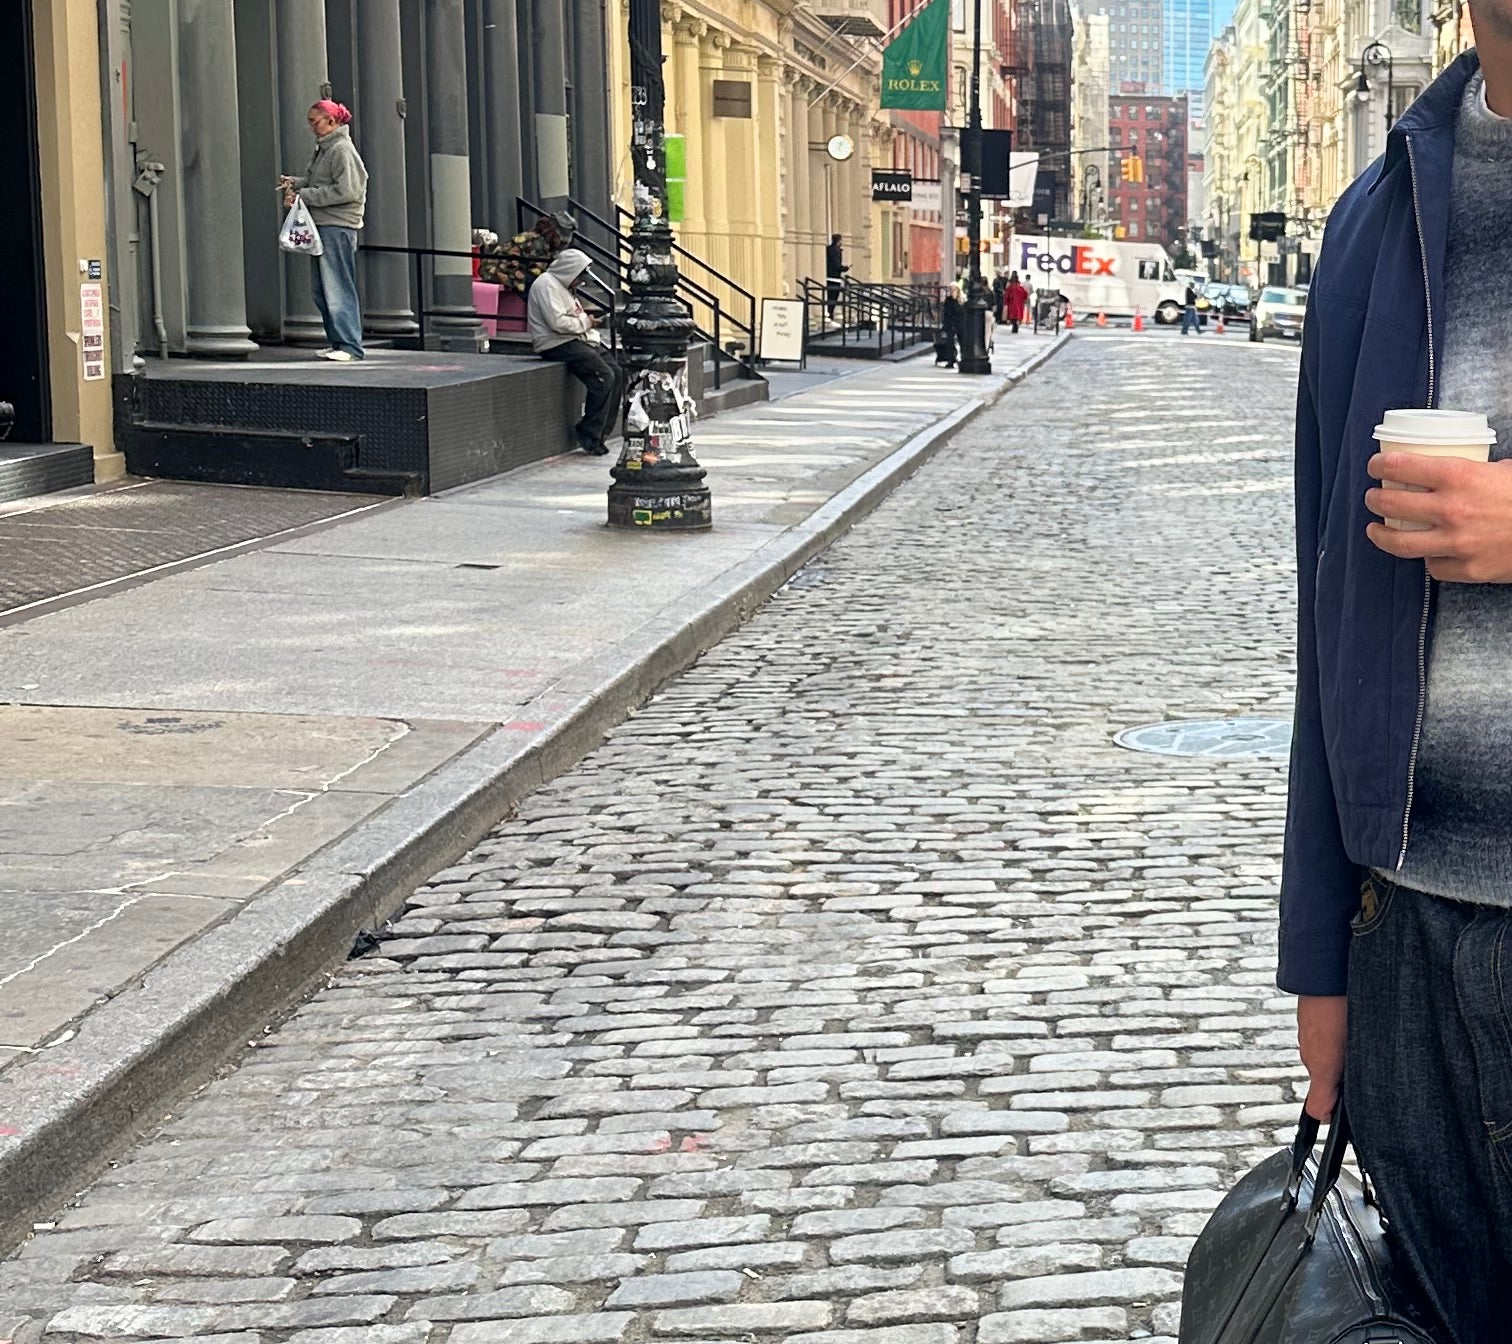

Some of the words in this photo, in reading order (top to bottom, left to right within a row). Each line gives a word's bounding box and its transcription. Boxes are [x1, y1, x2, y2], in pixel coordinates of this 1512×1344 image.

[888, 78, 941, 92] ROLEX
[872, 182, 911, 193] AFLALO
[1021, 242, 1116, 276] FedEx
